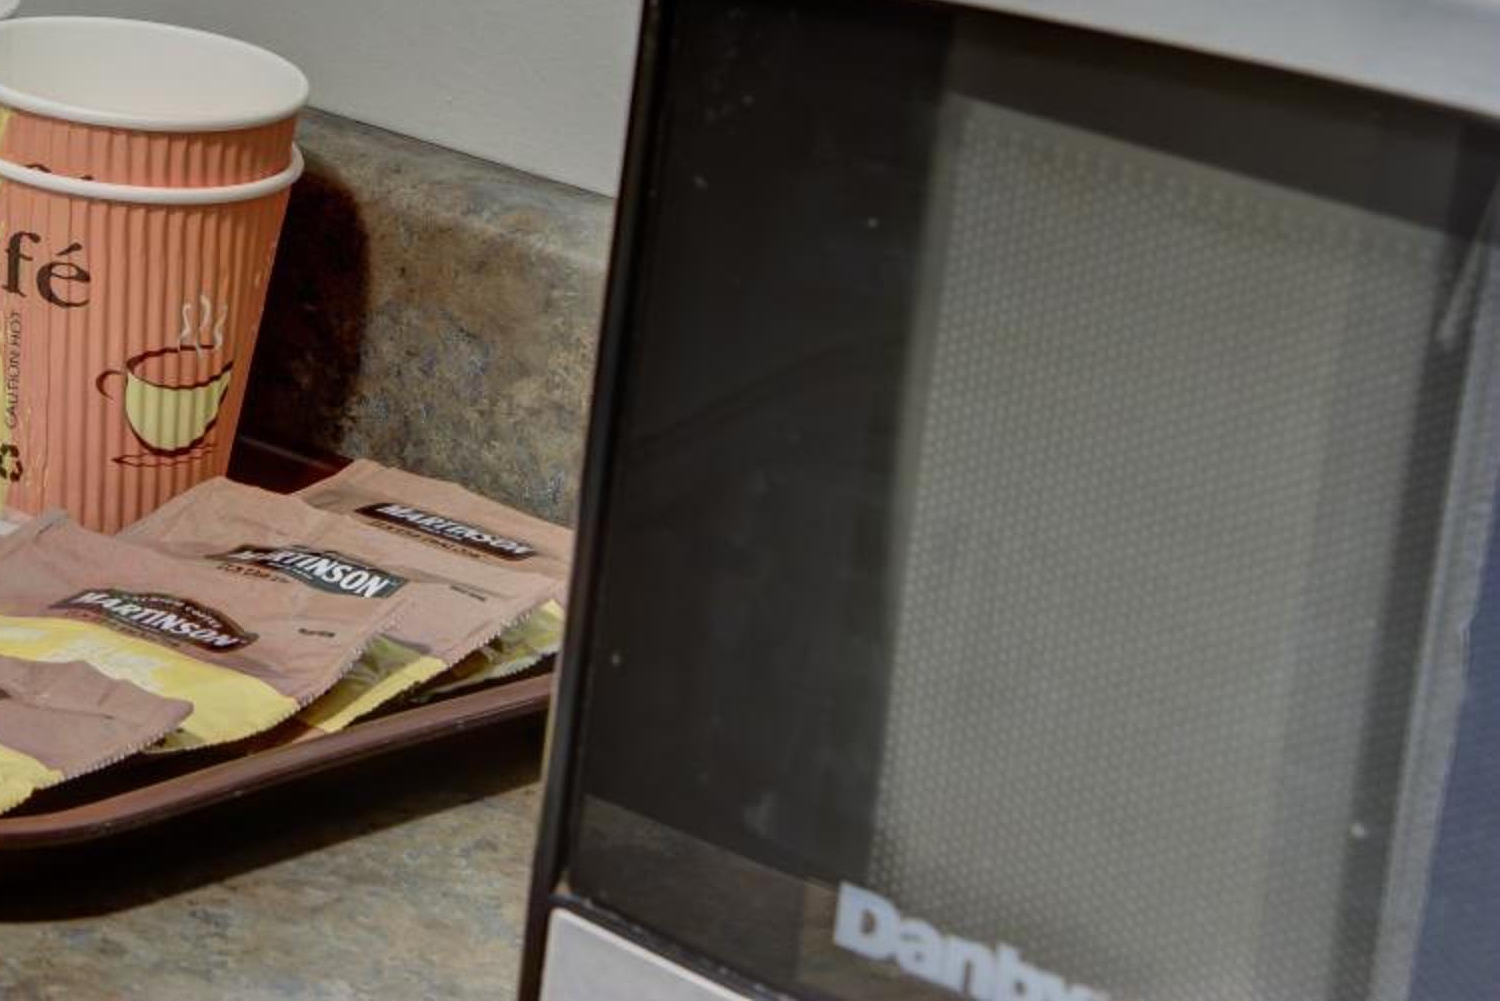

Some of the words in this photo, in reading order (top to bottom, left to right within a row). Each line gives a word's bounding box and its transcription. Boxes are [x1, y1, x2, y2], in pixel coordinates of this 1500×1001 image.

[10, 311, 22, 348] HOT
[5, 351, 21, 429] CAUTION
[69, 591, 240, 648] MARTINSON
